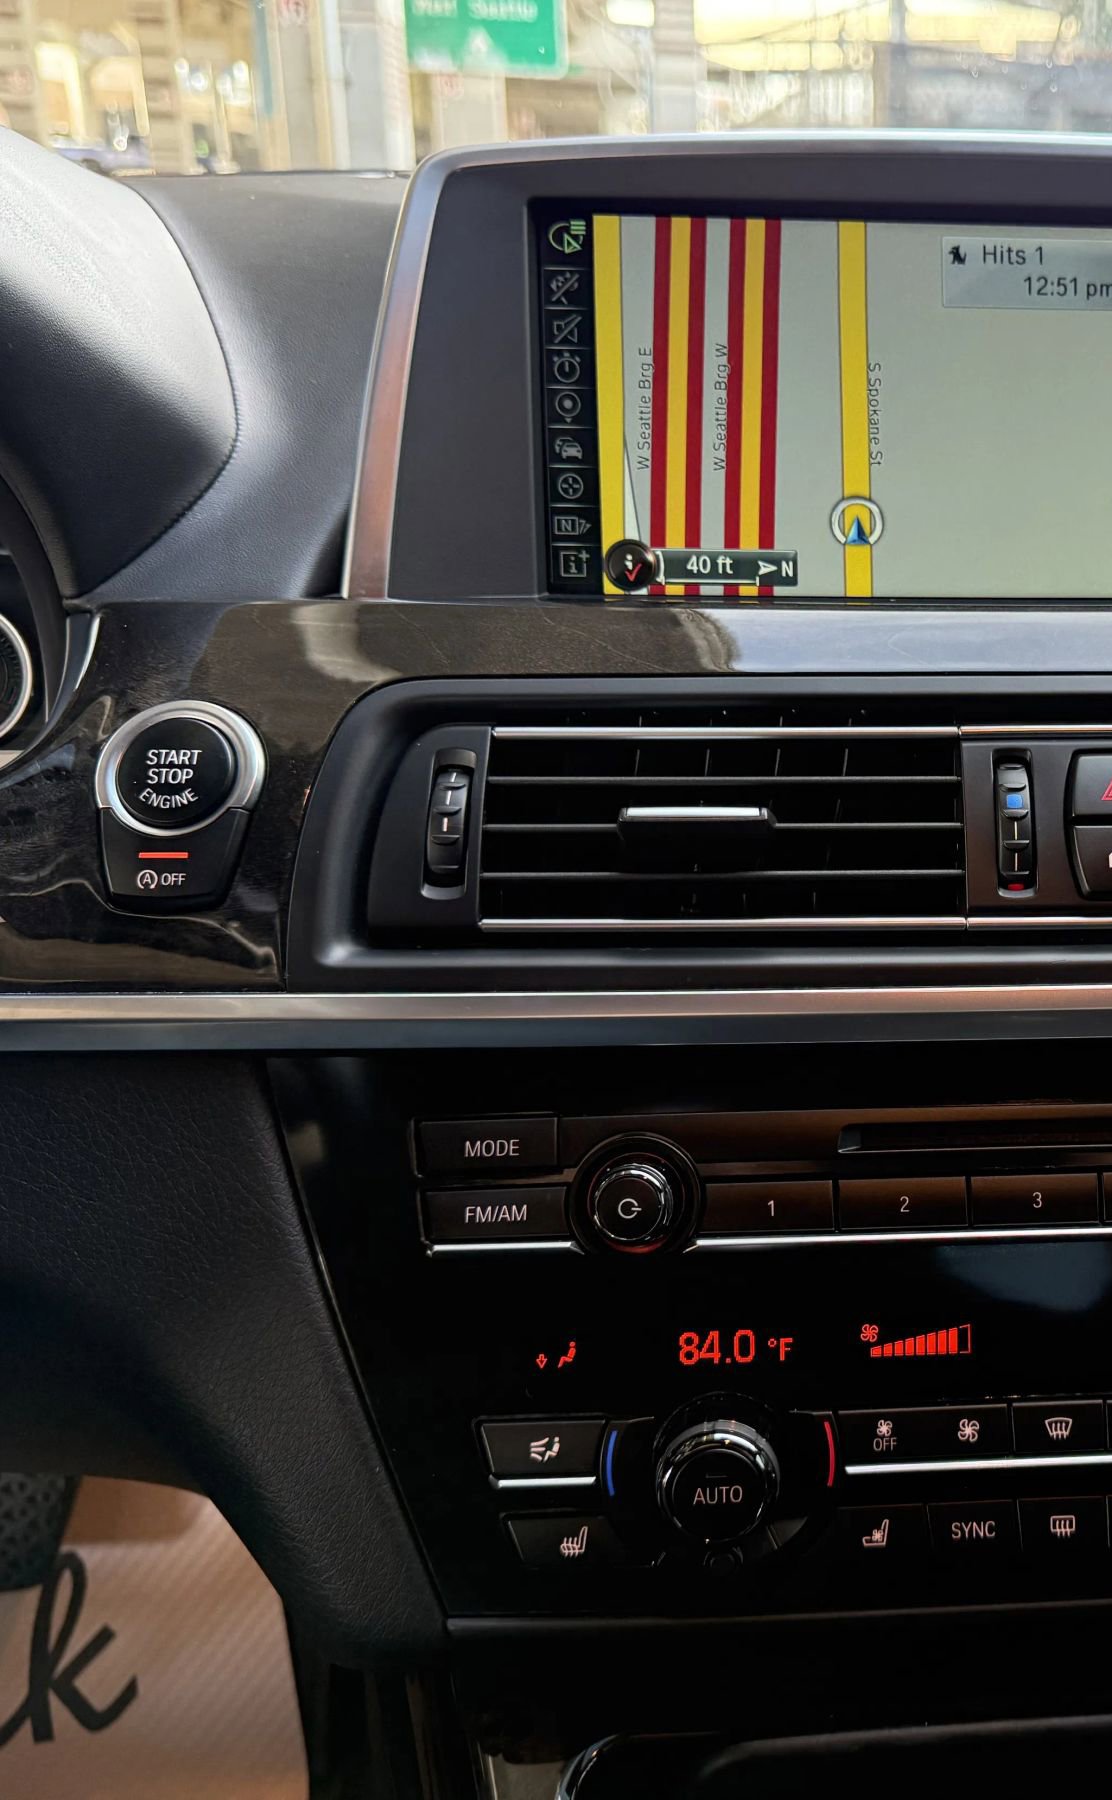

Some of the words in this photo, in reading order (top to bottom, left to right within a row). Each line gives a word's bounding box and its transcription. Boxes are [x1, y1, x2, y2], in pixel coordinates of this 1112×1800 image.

[983, 245, 1026, 265] Hits
[1035, 246, 1043, 265] 1
[1023, 276, 1078, 297] 12:51
[638, 347, 652, 357] E
[715, 343, 728, 356] W
[639, 362, 655, 389] Brg
[868, 362, 881, 373] S
[714, 364, 731, 391] Brg
[867, 378, 883, 446] Spokane
[637, 395, 651, 450] Seattle
[713, 396, 727, 451] Seattle
[637, 455, 650, 470] W
[713, 457, 726, 471] W
[869, 451, 883, 467] St
[686, 556, 711, 574] 40
[716, 556, 734, 574] ft
[781, 561, 794, 577] N
[146, 750, 202, 765] START
[147, 769, 193, 784] STOP
[138, 788, 198, 809] ENGINE
[161, 873, 186, 886] OFF
[464, 1140, 520, 1157] MODE
[767, 1200, 775, 1217] 1
[899, 1196, 910, 1213] 2
[1031, 1192, 1042, 1209] 3
[464, 1205, 528, 1224] FM/AM
[678, 1330, 755, 1365] 84.0
[768, 1338, 793, 1362] °F
[873, 1437, 897, 1452] OFF
[693, 1485, 743, 1505] AUTO
[951, 1521, 996, 1539] SYNC
